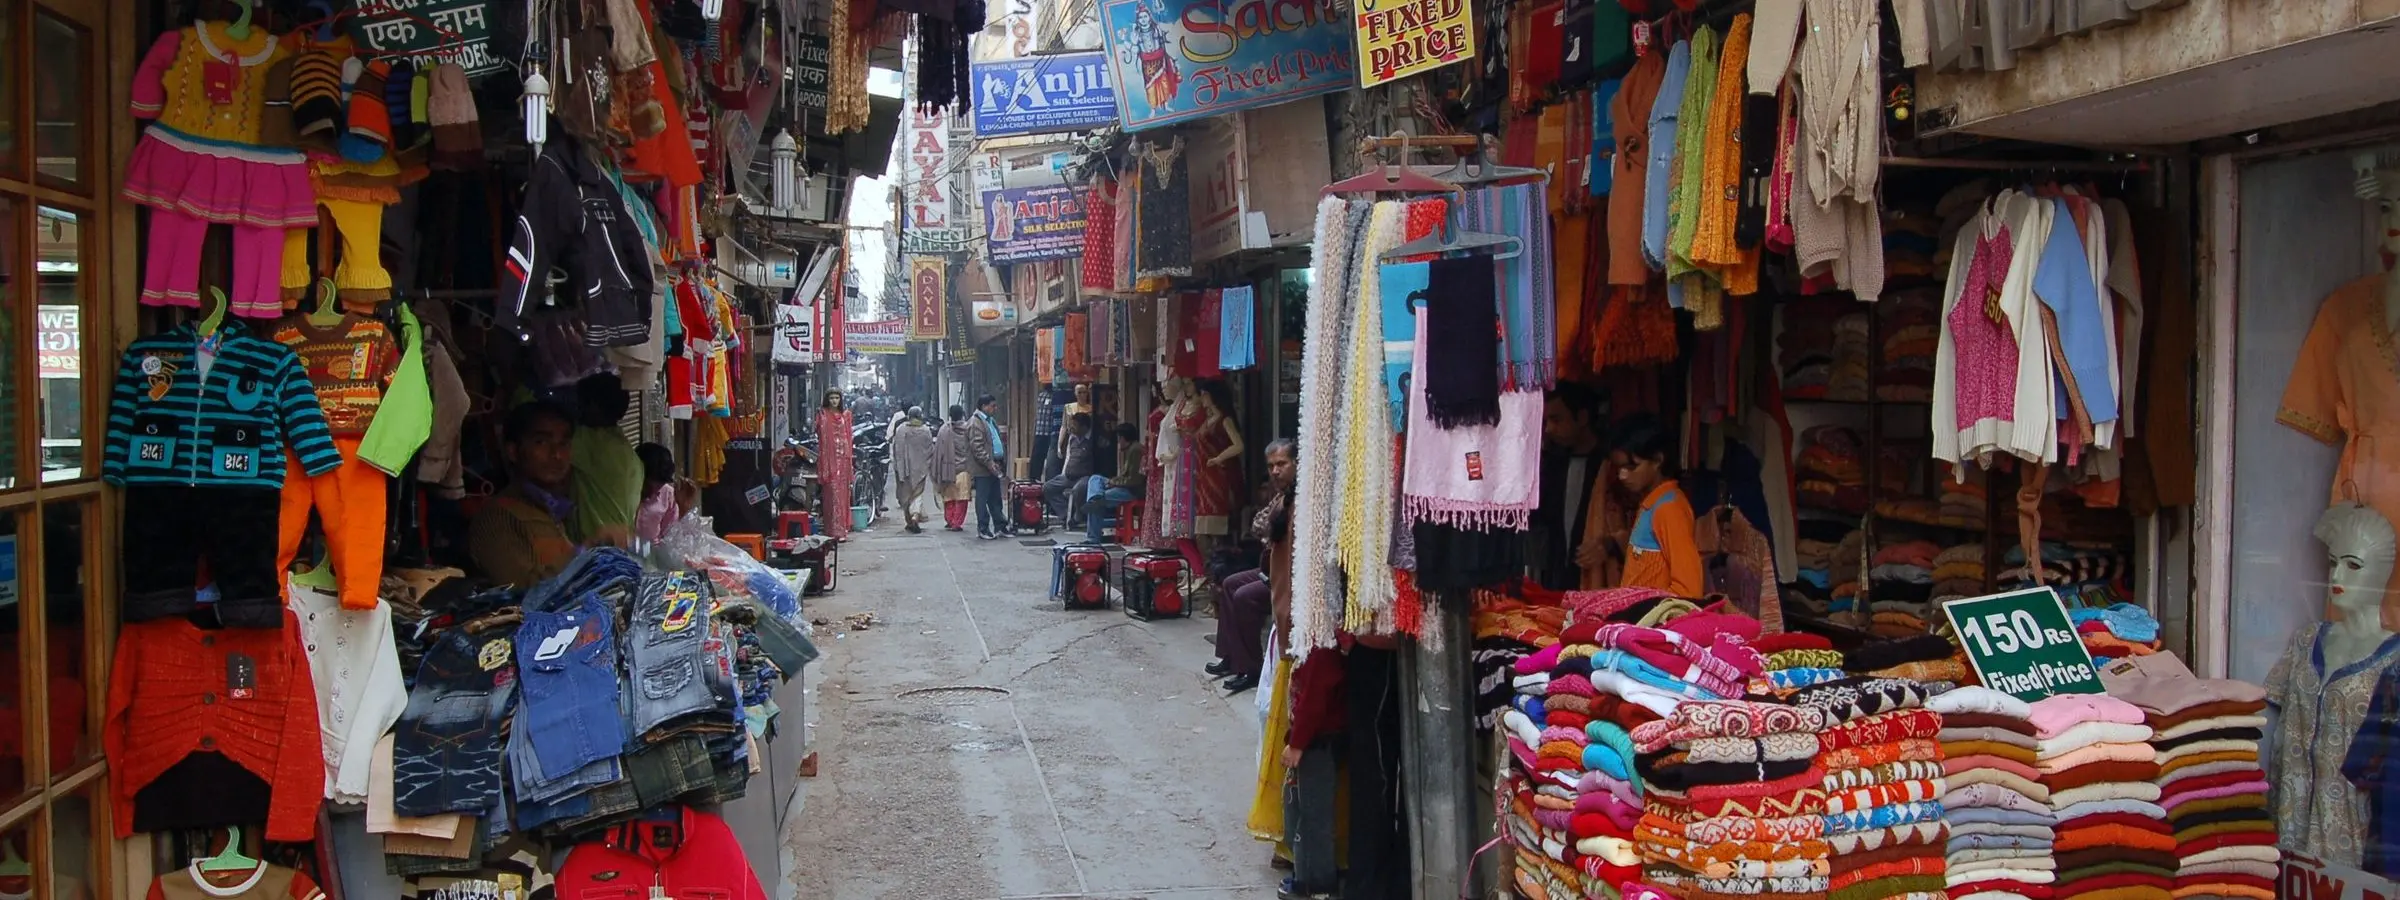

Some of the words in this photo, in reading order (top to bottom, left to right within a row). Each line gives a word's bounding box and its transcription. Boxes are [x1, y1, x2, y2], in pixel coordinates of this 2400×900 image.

[362, 17, 417, 50] एक
[1366, 0, 1463, 43] FIXED
[1370, 23, 1467, 76] PRICE
[1190, 54, 1281, 106] Fixed
[794, 91, 826, 108] APOOR
[1053, 97, 1071, 106] Silk
[1023, 225, 1043, 235] SILK
[922, 275, 935, 326] DAYAL
[1984, 289, 2002, 323] 350
[141, 443, 158, 460] BIG
[225, 453, 243, 471] BIG
[1963, 609, 2044, 657] 150
[2044, 628, 2073, 645] Rs
[1987, 665, 2042, 695] Fixed
[2040, 661, 2092, 687] Price
